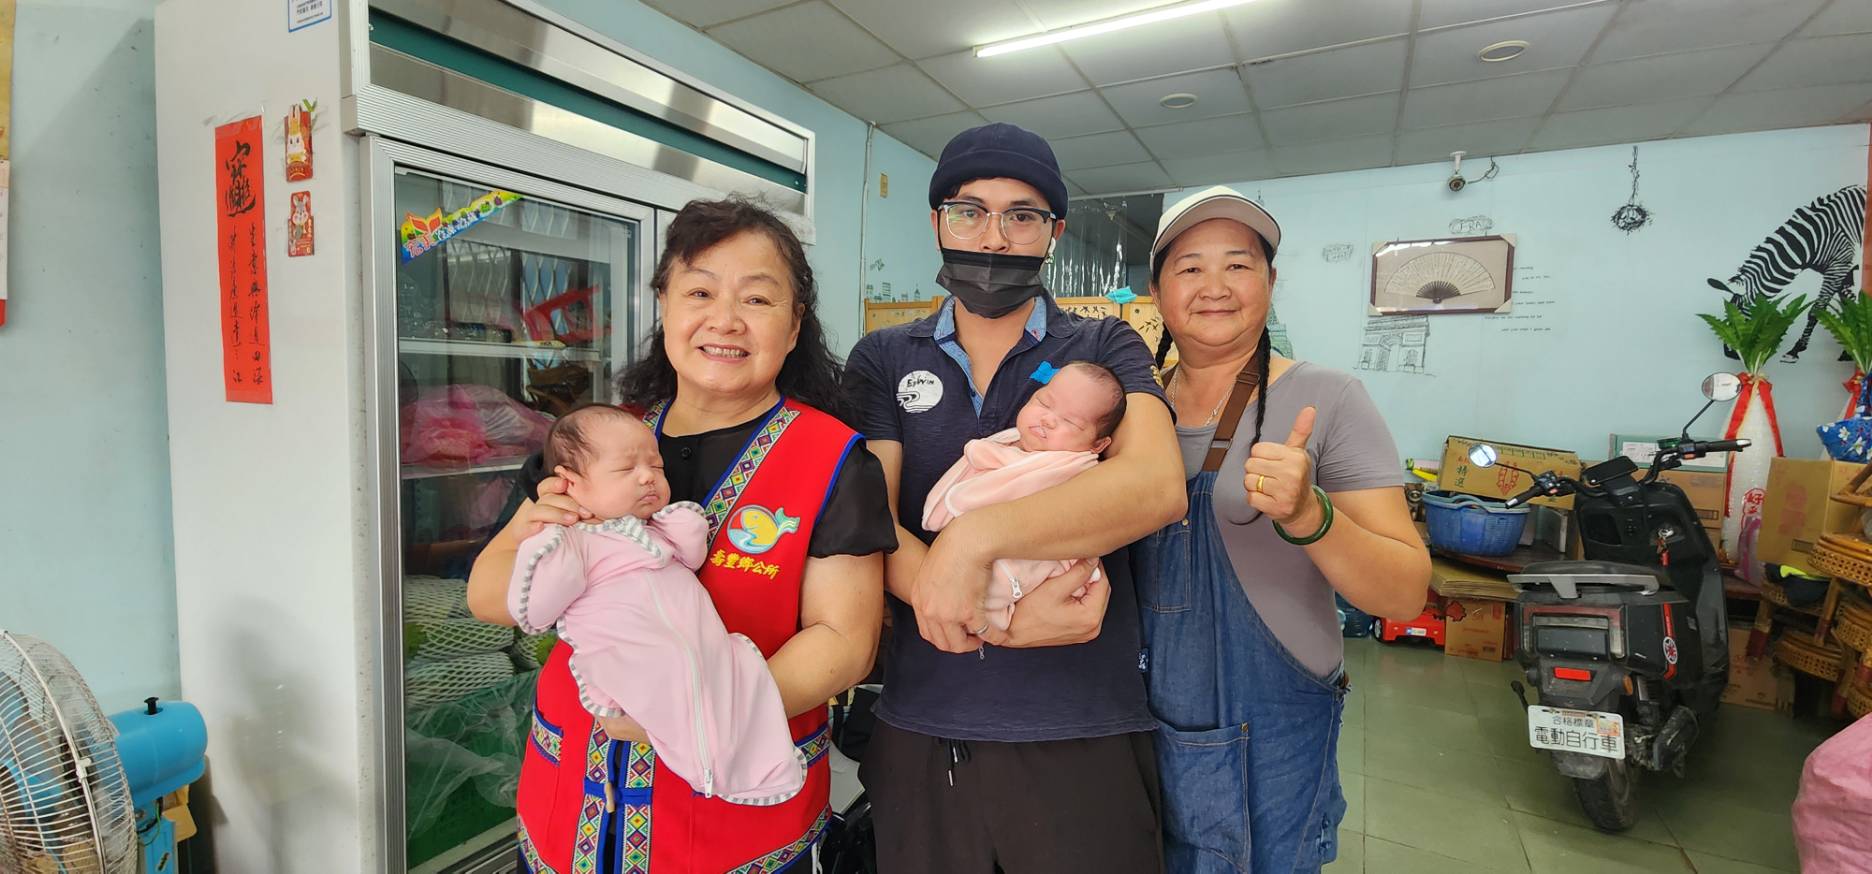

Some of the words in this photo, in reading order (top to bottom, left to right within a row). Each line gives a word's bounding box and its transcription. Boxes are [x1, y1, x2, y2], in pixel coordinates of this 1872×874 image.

[1535, 726, 1618, 753] 電動自行車
